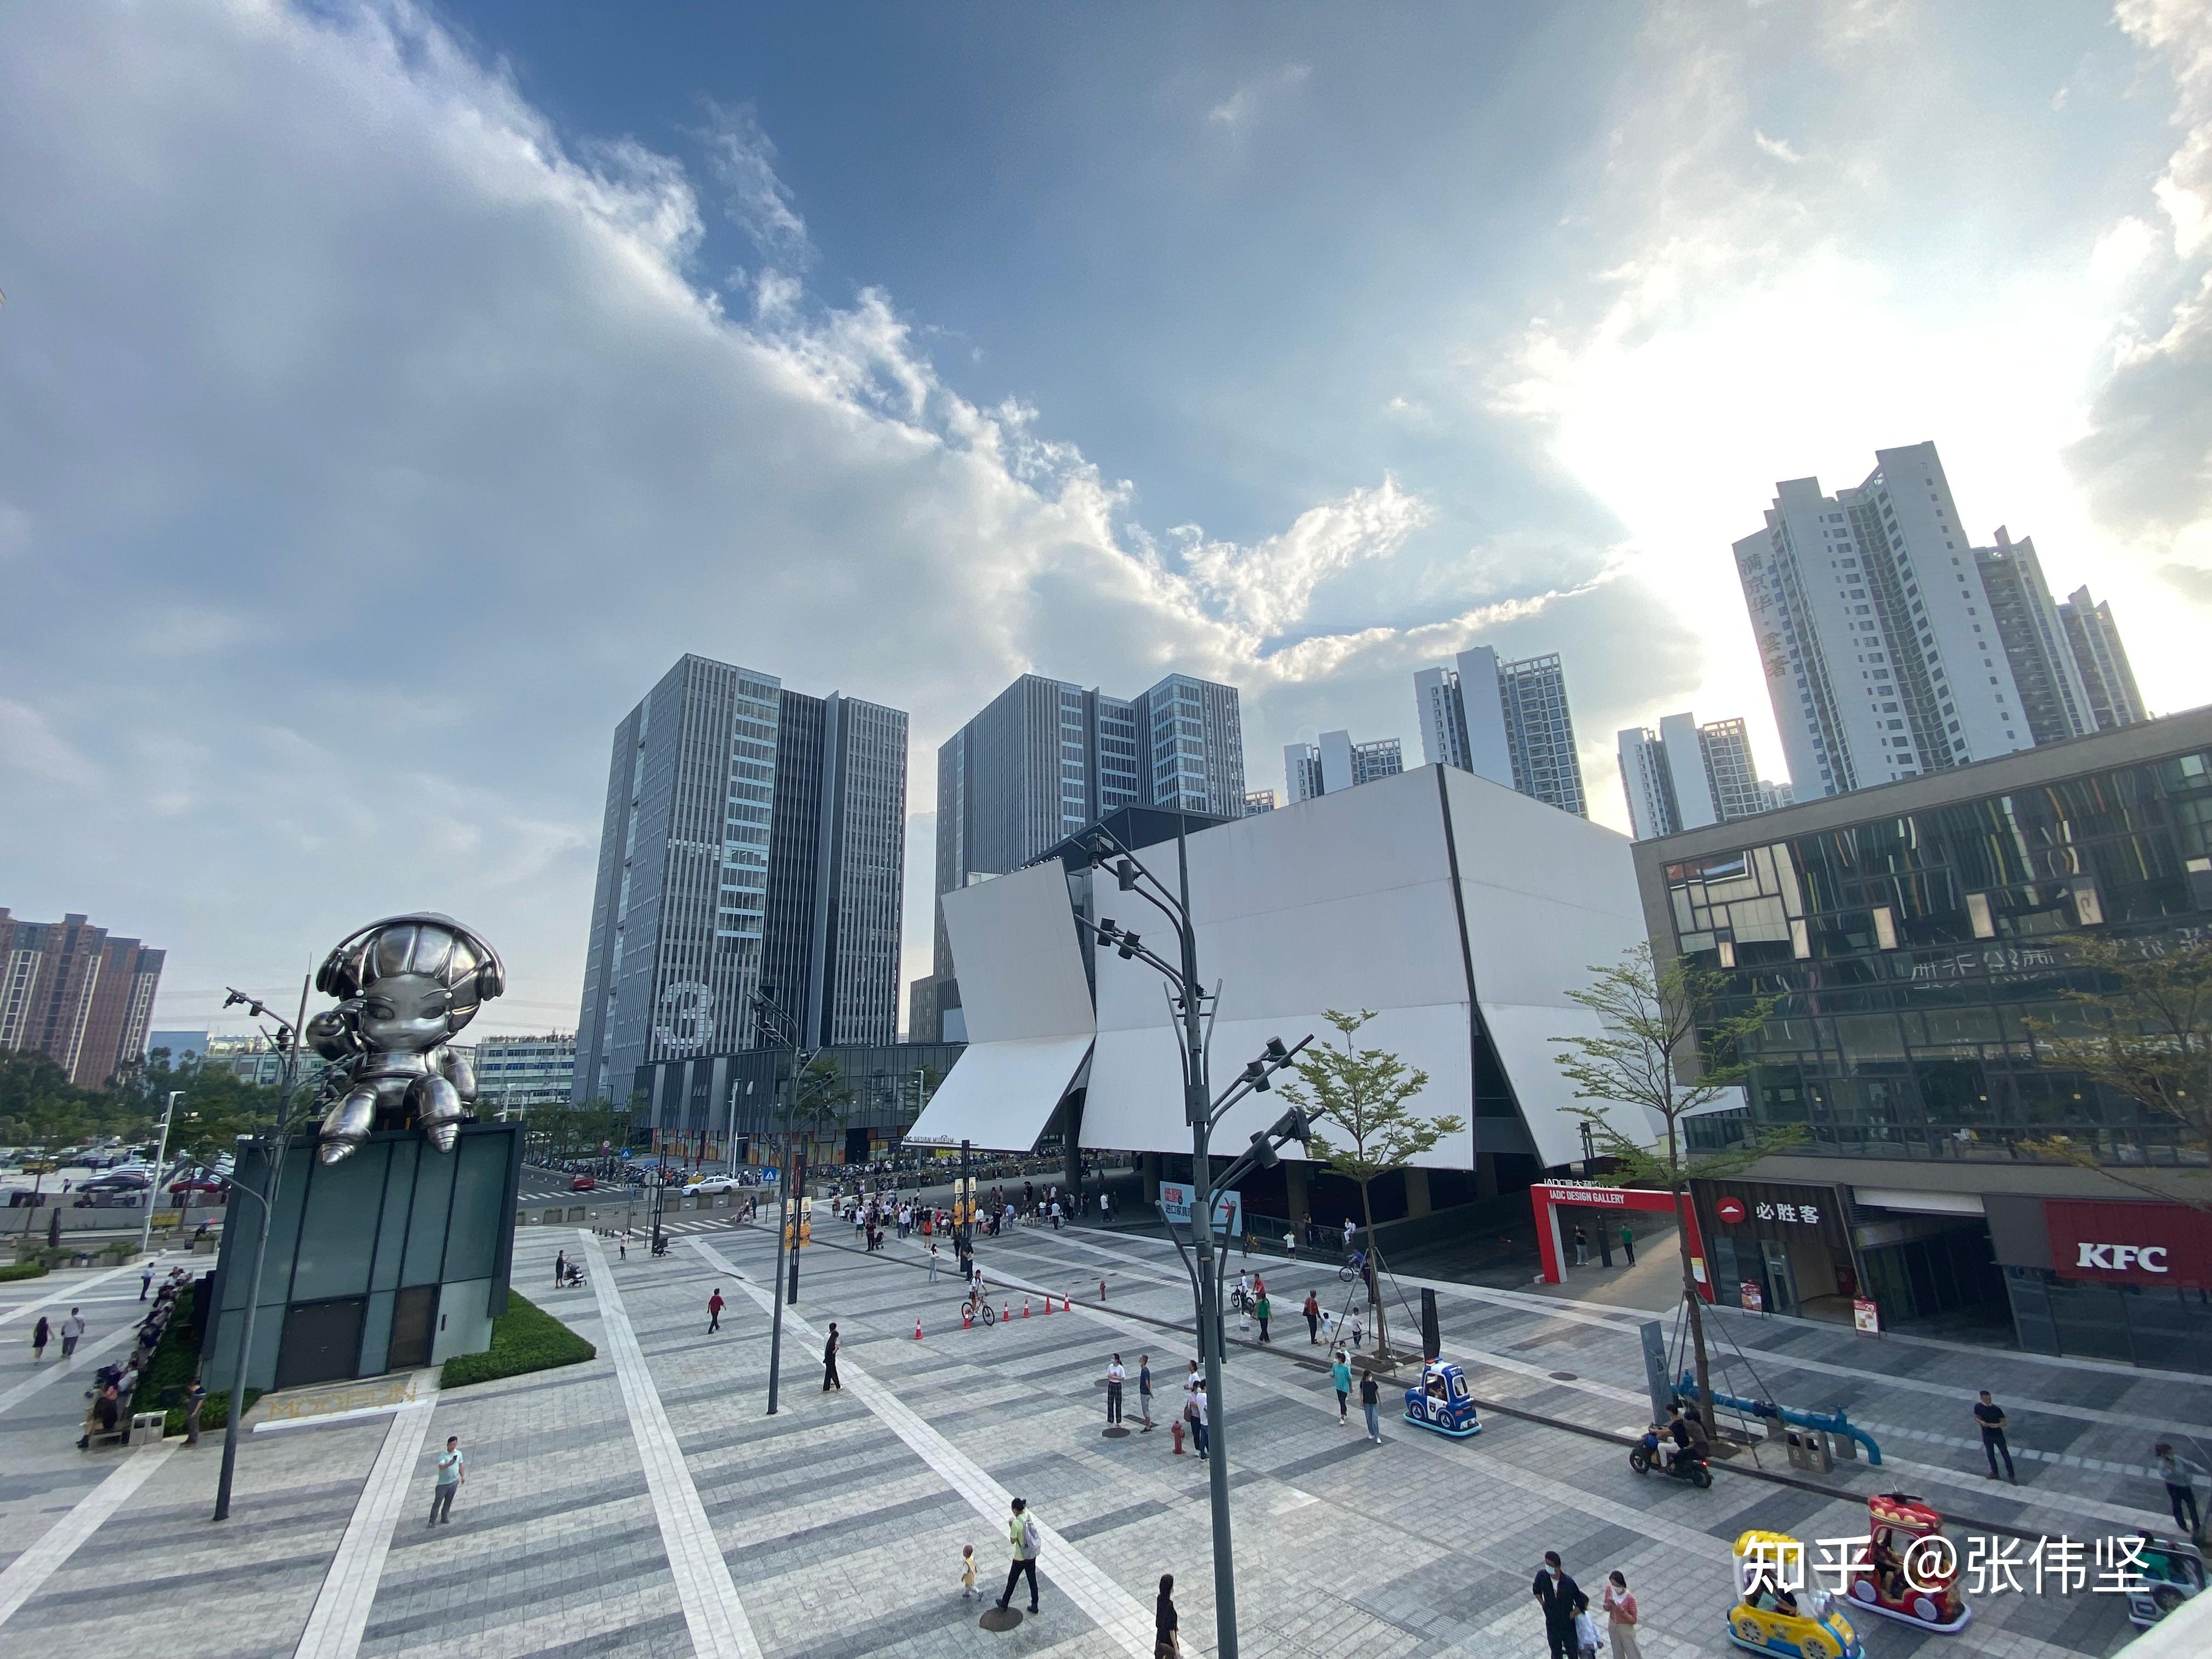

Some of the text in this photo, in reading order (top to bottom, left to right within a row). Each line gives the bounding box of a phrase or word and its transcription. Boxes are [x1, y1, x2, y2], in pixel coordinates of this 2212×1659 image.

[1550, 1190, 1624, 1204] IADC DESIGN GALLERY
[1756, 1201, 1819, 1224] 必胜客
[2076, 1242, 2169, 1273] KFC
